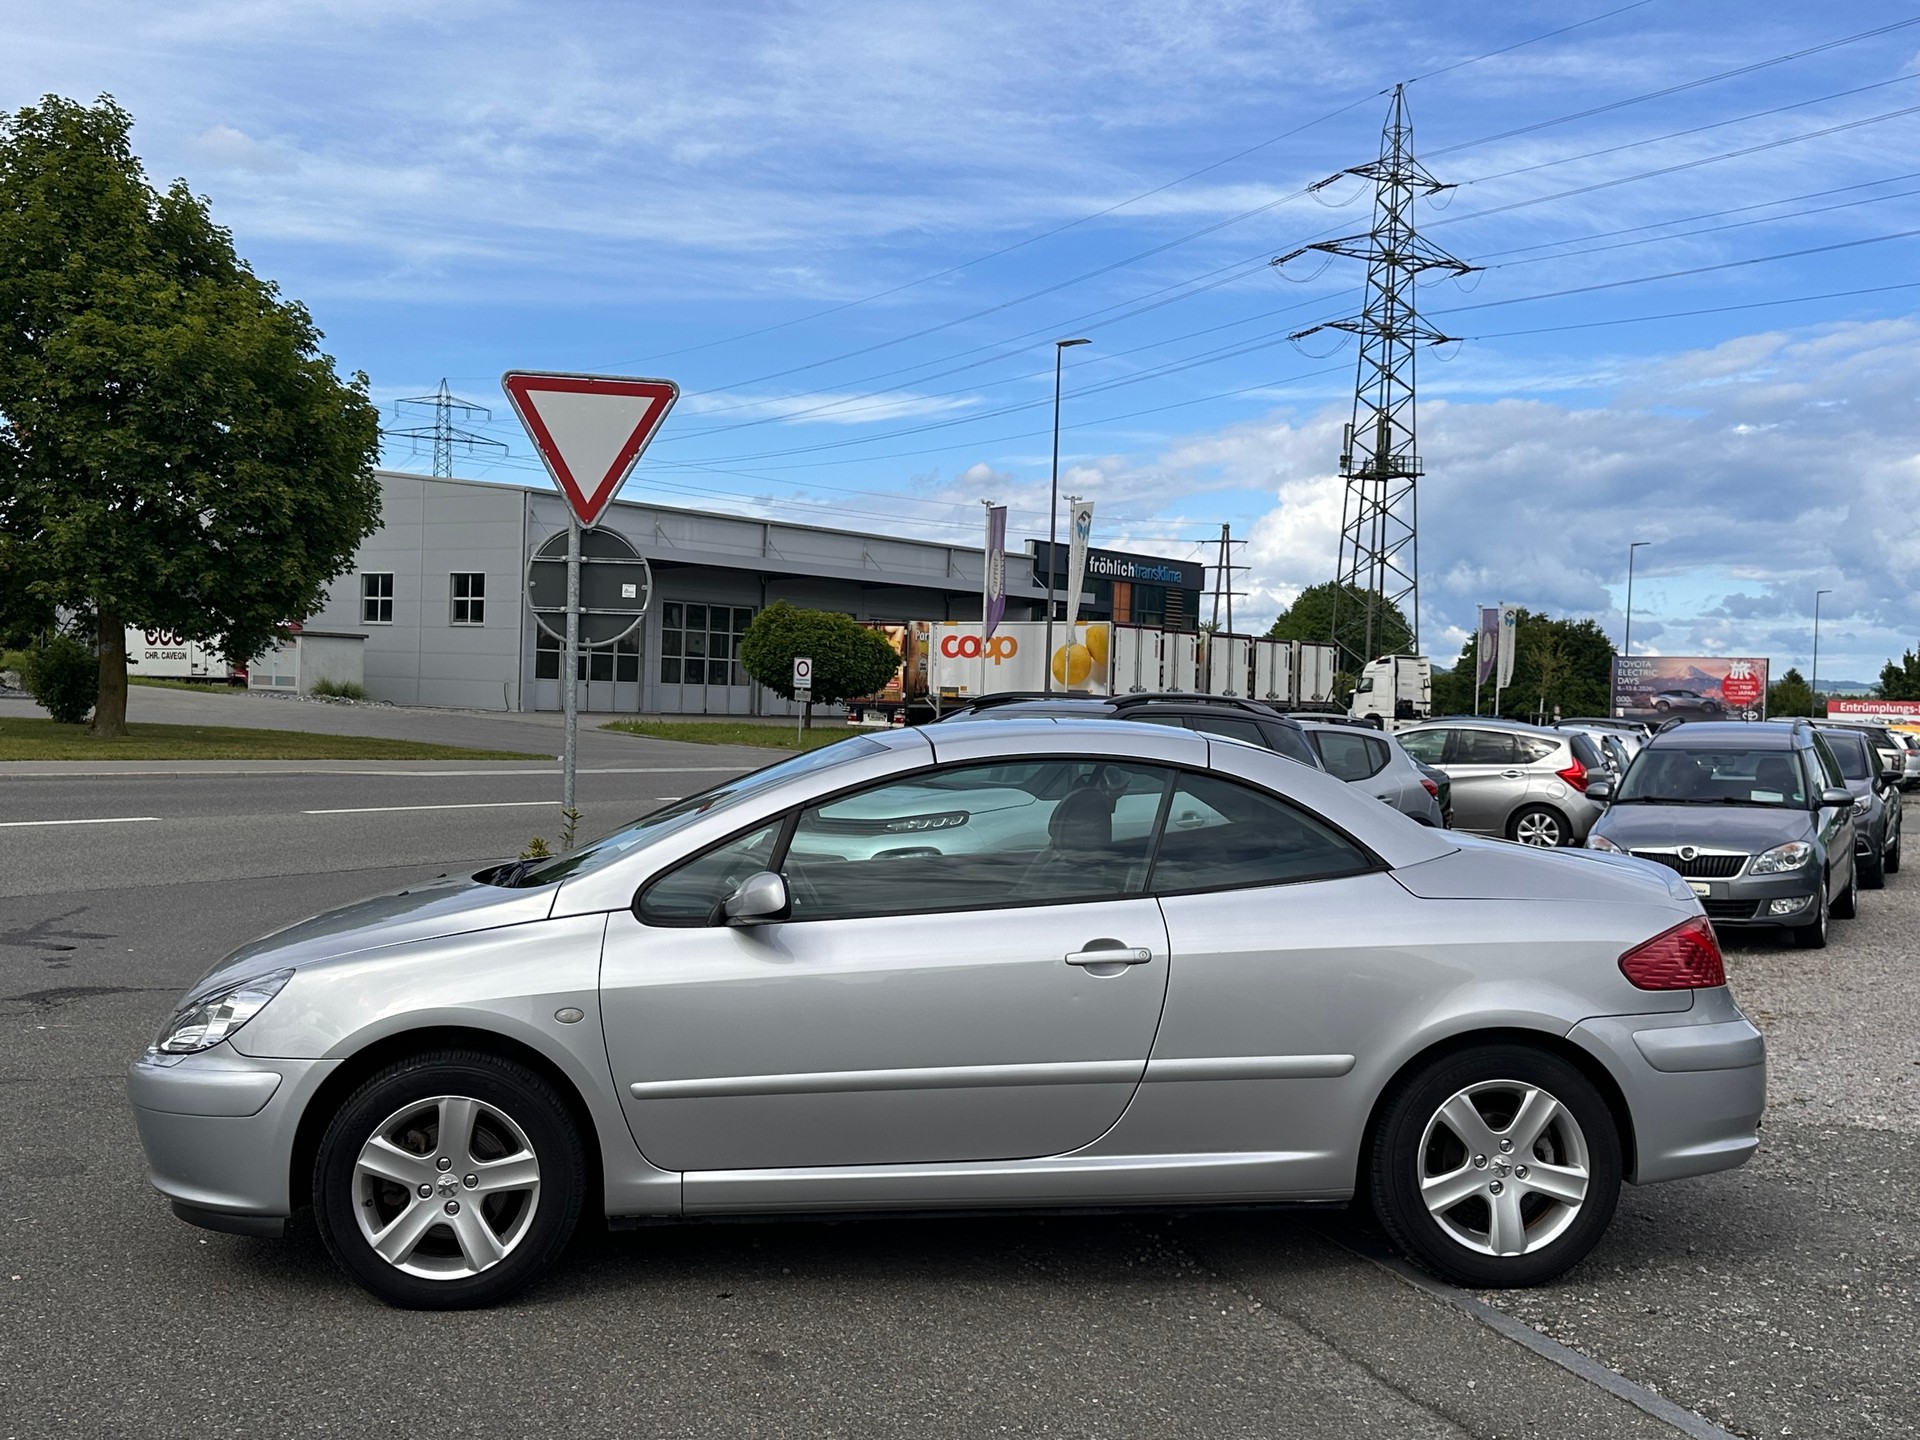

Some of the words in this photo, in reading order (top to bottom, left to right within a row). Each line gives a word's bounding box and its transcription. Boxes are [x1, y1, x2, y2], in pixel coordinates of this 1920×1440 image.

[941, 635, 1018, 665] coop
[145, 651, 160, 660] CHR.
[161, 651, 187, 660] CAVEGN
[1618, 660, 1652, 668] TOYOTA
[1618, 669, 1659, 677] ELECTRIC
[1617, 677, 1640, 685] DAYS
